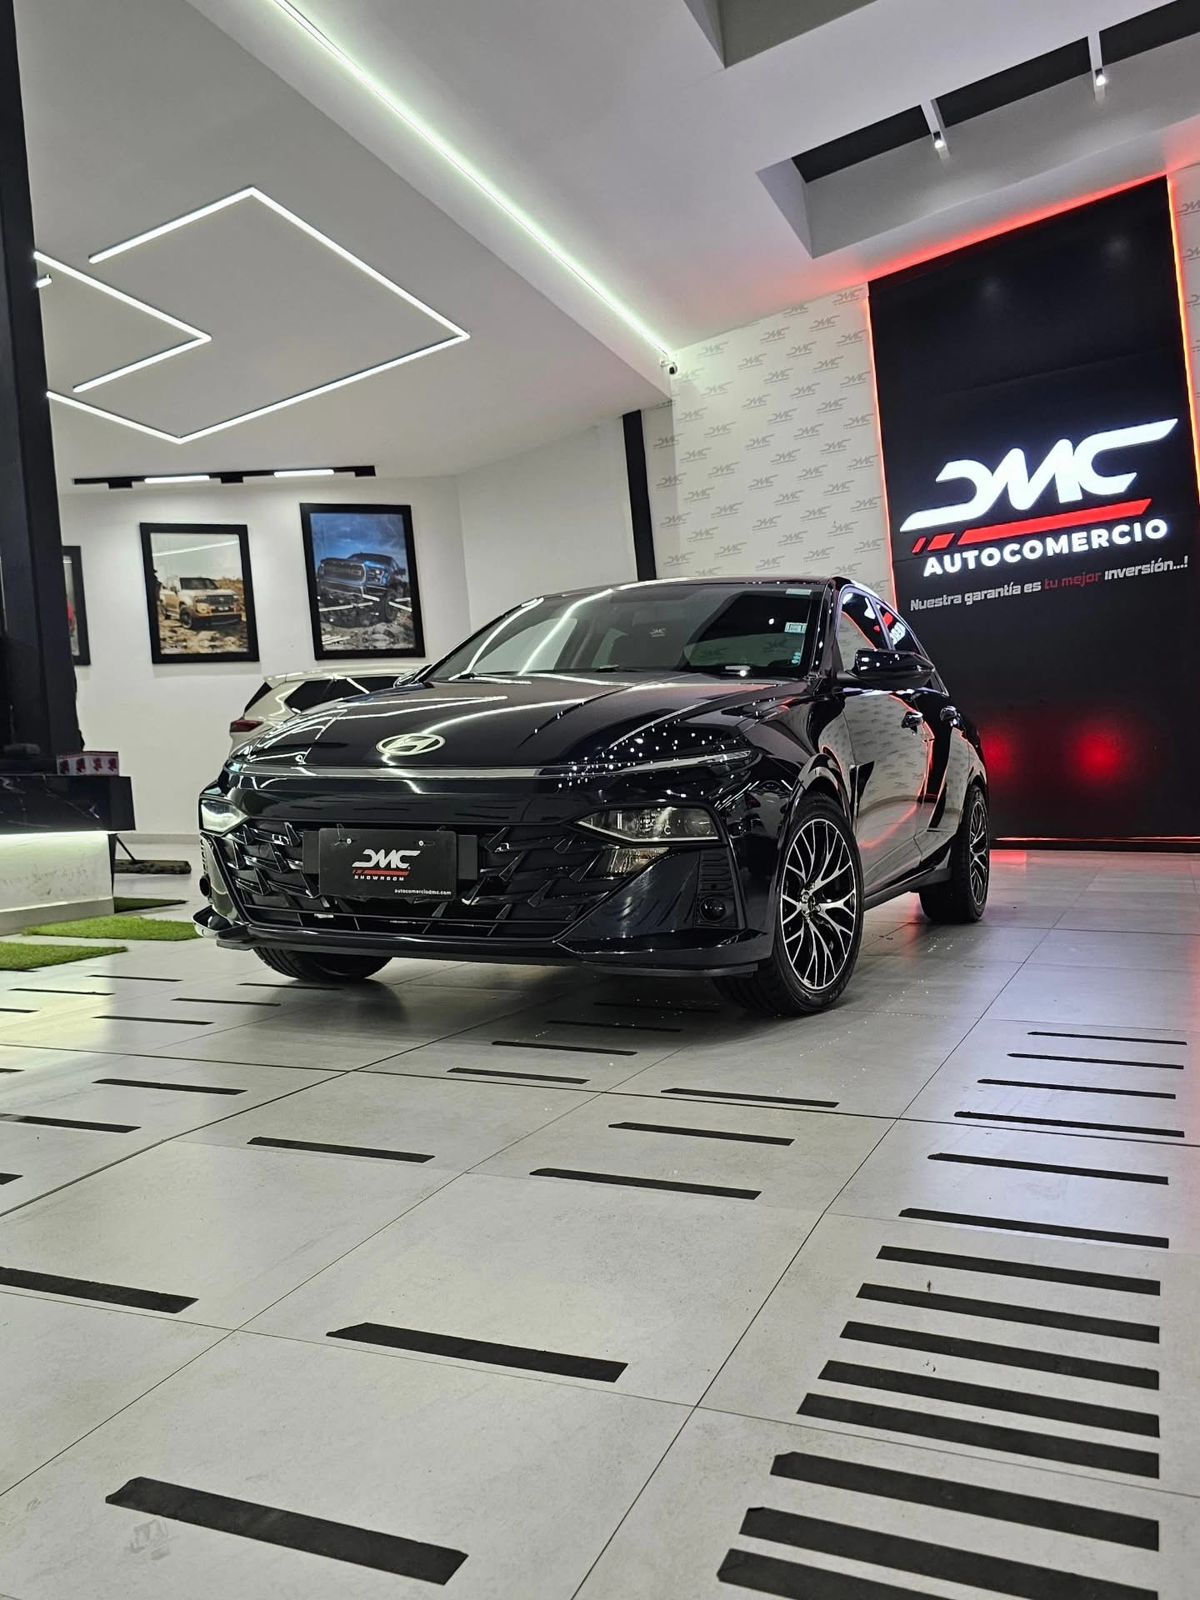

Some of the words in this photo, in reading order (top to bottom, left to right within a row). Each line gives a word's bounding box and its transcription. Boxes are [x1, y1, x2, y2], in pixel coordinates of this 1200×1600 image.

[900, 418, 1178, 532] DMC
[923, 518, 1168, 577] AUTOCOMERCIO
[910, 594, 962, 611] Nuestra
[964, 581, 1021, 605] garantía
[1023, 581, 1042, 593] es
[1044, 578, 1058, 590] tu
[1061, 571, 1103, 588] mejor
[352, 848, 421, 869] DMC
